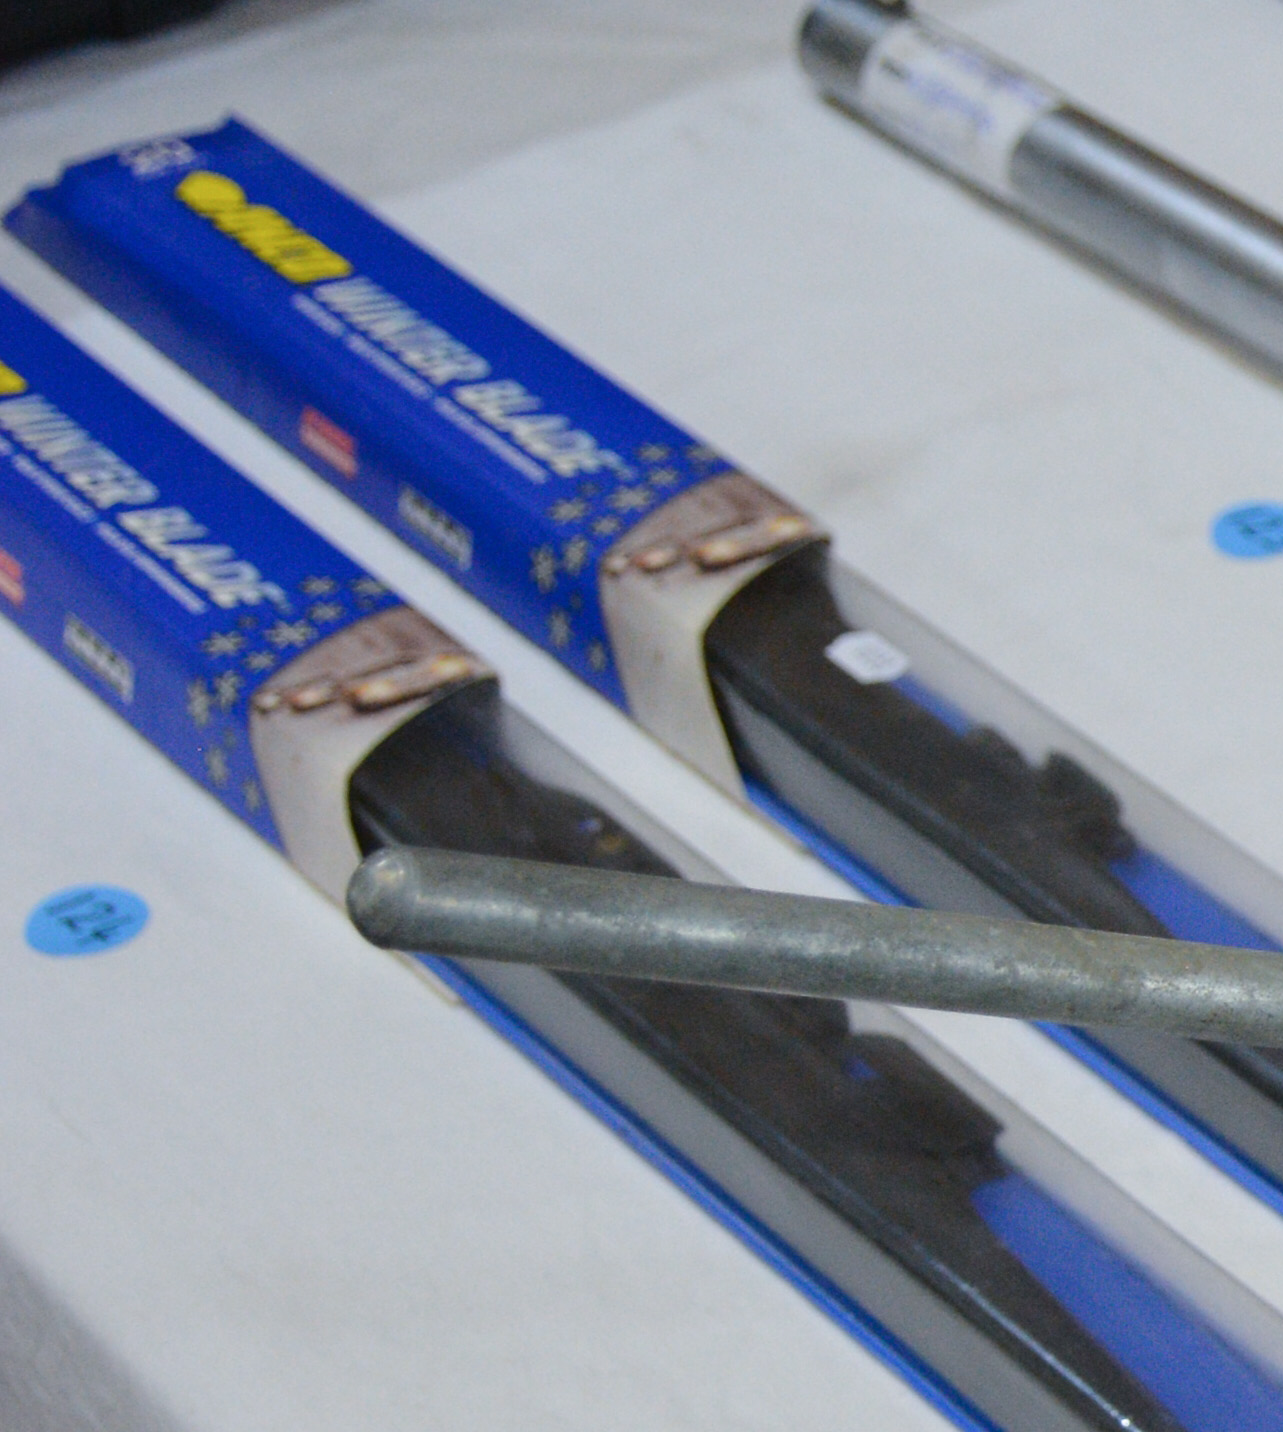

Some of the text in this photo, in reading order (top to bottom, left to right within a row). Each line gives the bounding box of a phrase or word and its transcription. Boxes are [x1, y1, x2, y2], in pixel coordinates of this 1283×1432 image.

[313, 275, 493, 386] WINTER
[452, 378, 636, 482] BLADE
[116, 504, 292, 615] BLADE
[43, 890, 136, 947] 124
